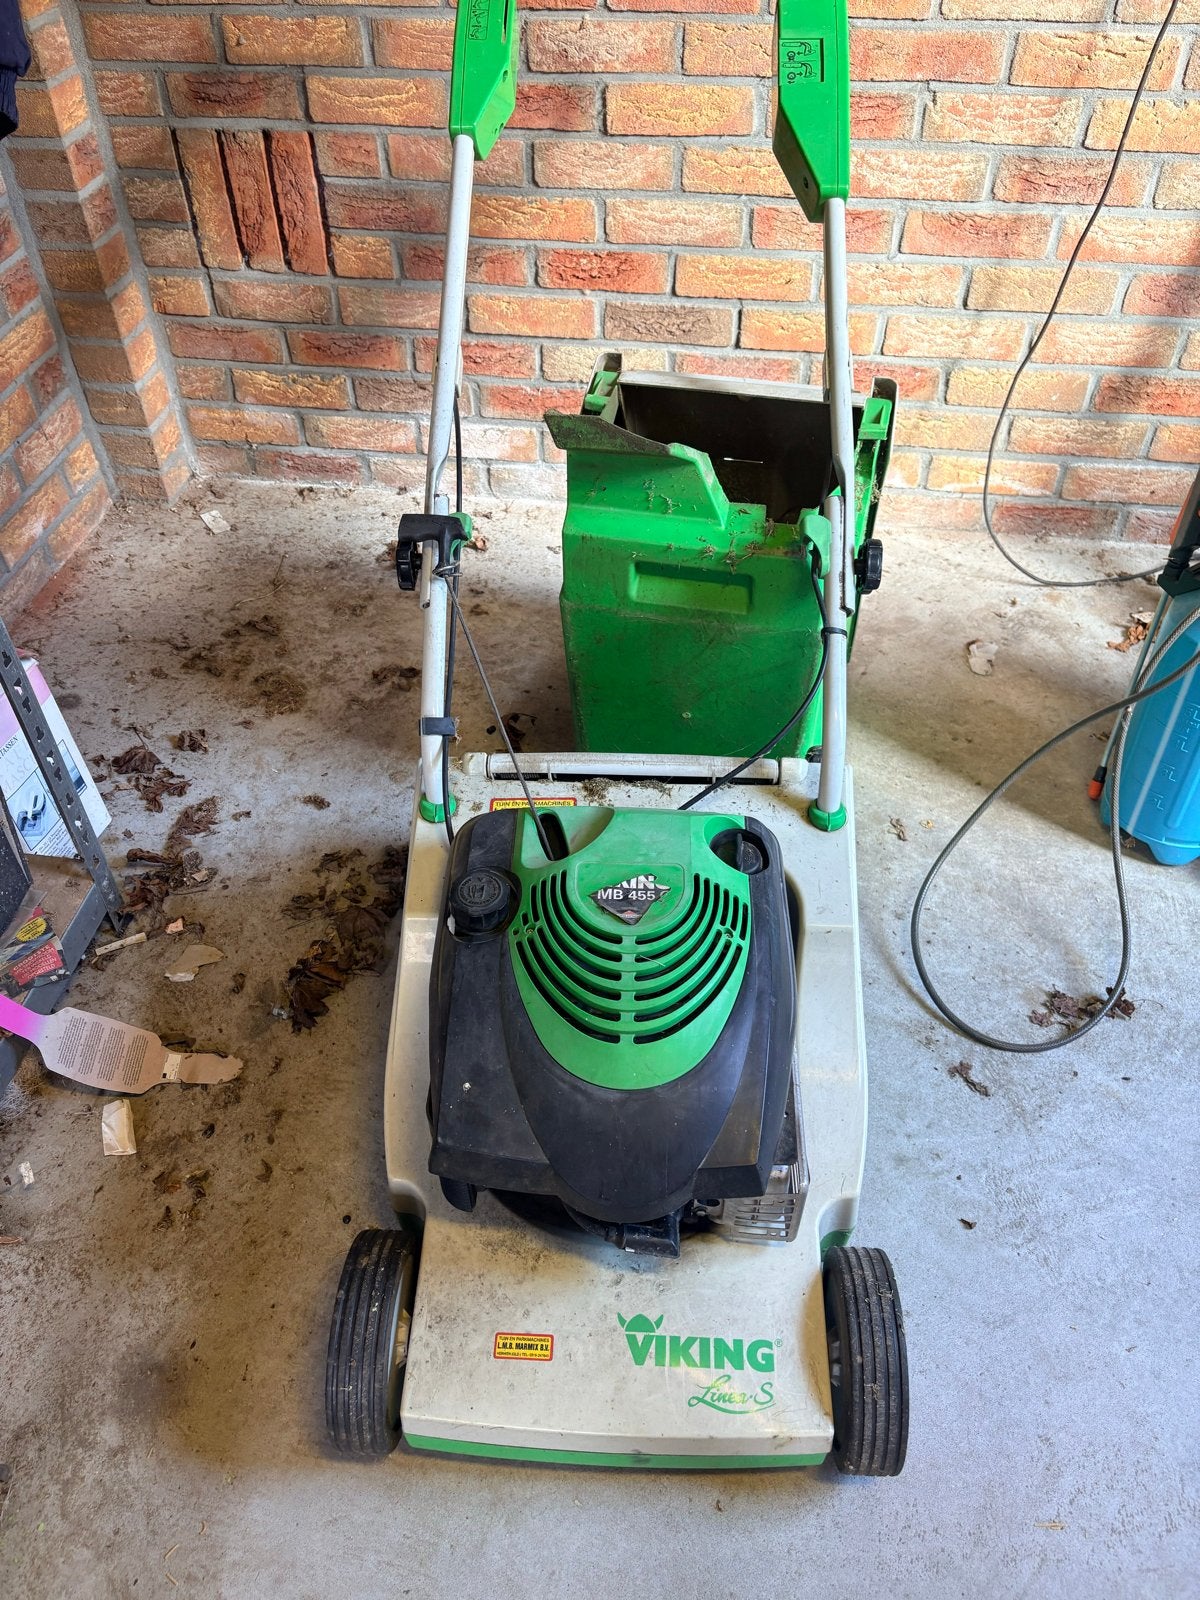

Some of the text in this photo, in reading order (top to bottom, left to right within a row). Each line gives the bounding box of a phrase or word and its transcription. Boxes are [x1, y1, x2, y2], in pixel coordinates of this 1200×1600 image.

[0, 735, 18, 759] TASSEN
[597, 888, 624, 900] MB
[628, 890, 656, 901] 455
[515, 1342, 539, 1351] MARMIX
[625, 1333, 775, 1373] VIKING
